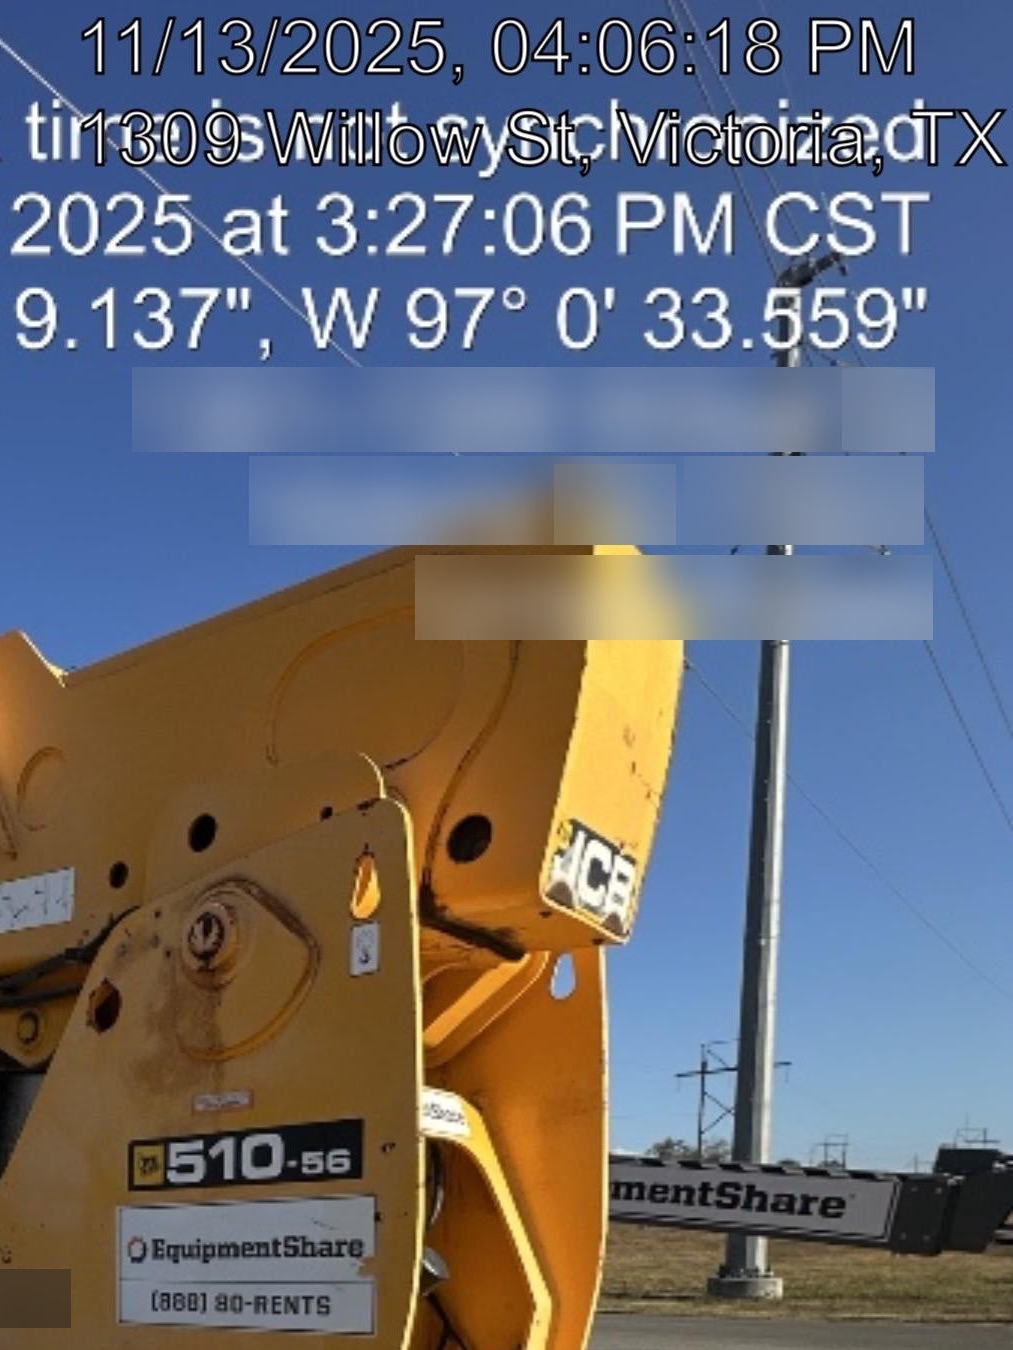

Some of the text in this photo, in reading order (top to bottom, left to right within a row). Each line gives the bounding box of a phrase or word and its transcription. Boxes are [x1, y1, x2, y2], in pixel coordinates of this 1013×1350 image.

[548, 828, 636, 937] JCB
[166, 1132, 352, 1184] 510-56
[608, 1180, 847, 1219] mentShare
[151, 1235, 364, 1264] EquipmentShare
[214, 1293, 332, 1317] 80-RENTS
